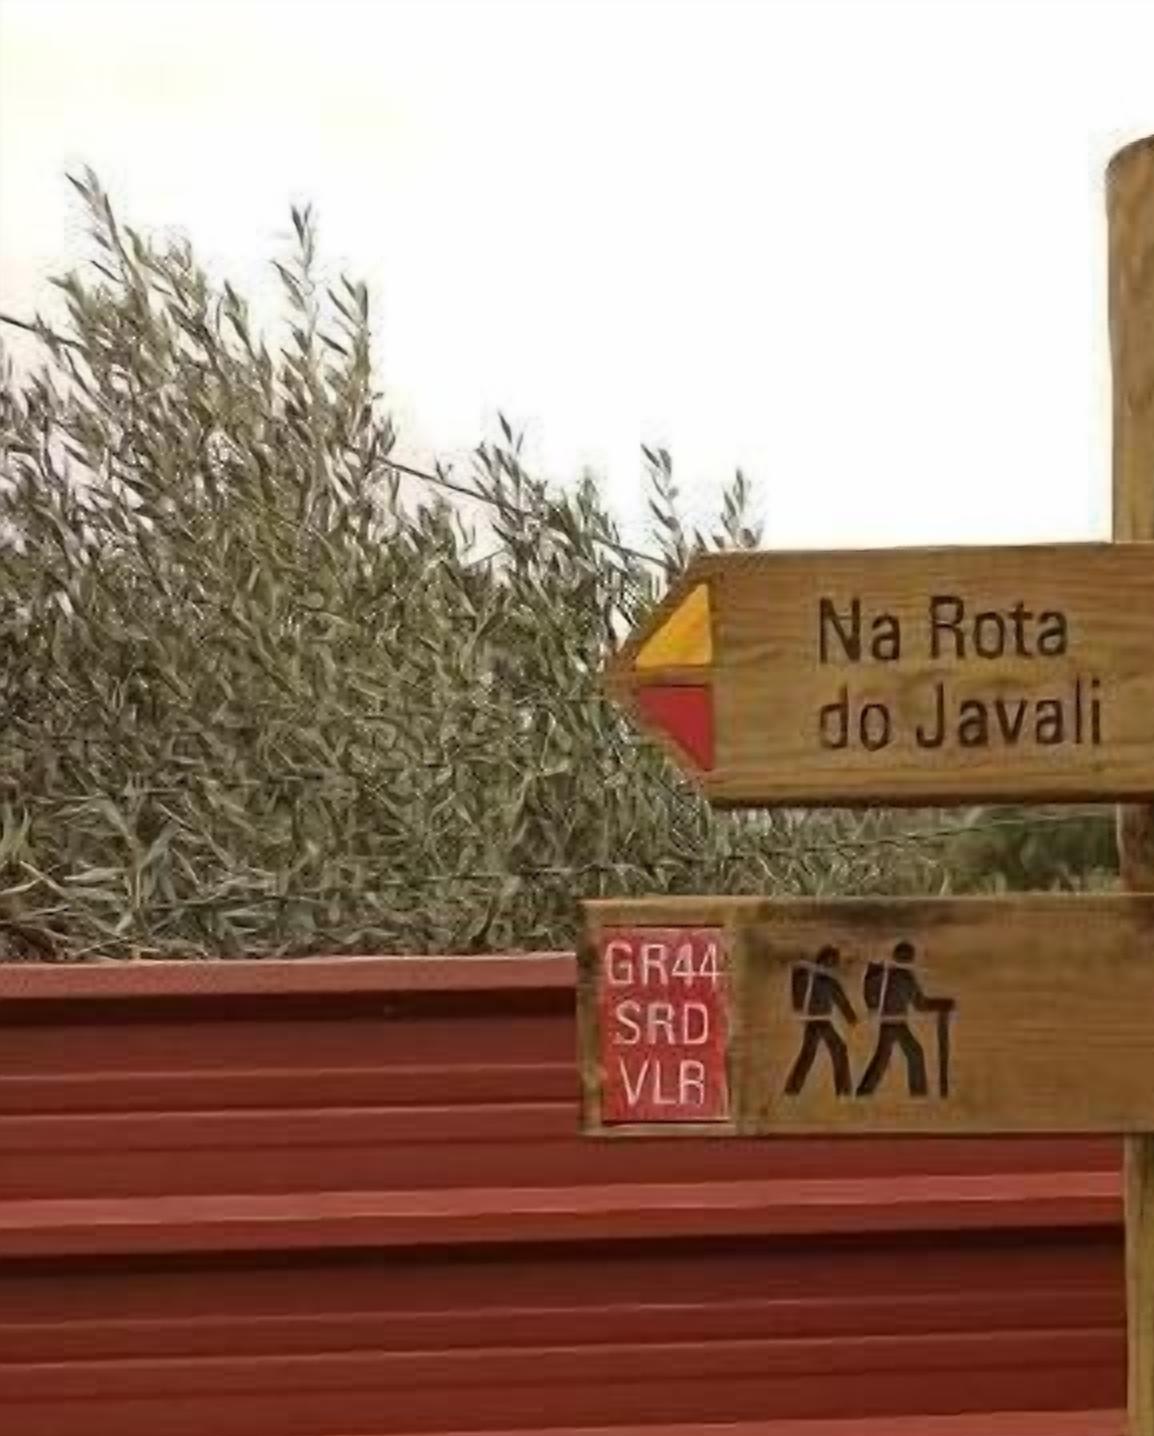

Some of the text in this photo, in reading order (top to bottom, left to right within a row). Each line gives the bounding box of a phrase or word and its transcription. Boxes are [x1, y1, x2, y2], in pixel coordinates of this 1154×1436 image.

[819, 595, 1068, 664] Na Rota
[819, 673, 1102, 751] do Javali
[605, 940, 722, 987] GR44
[613, 1000, 709, 1046] SRD
[619, 1056, 706, 1107] VLR
